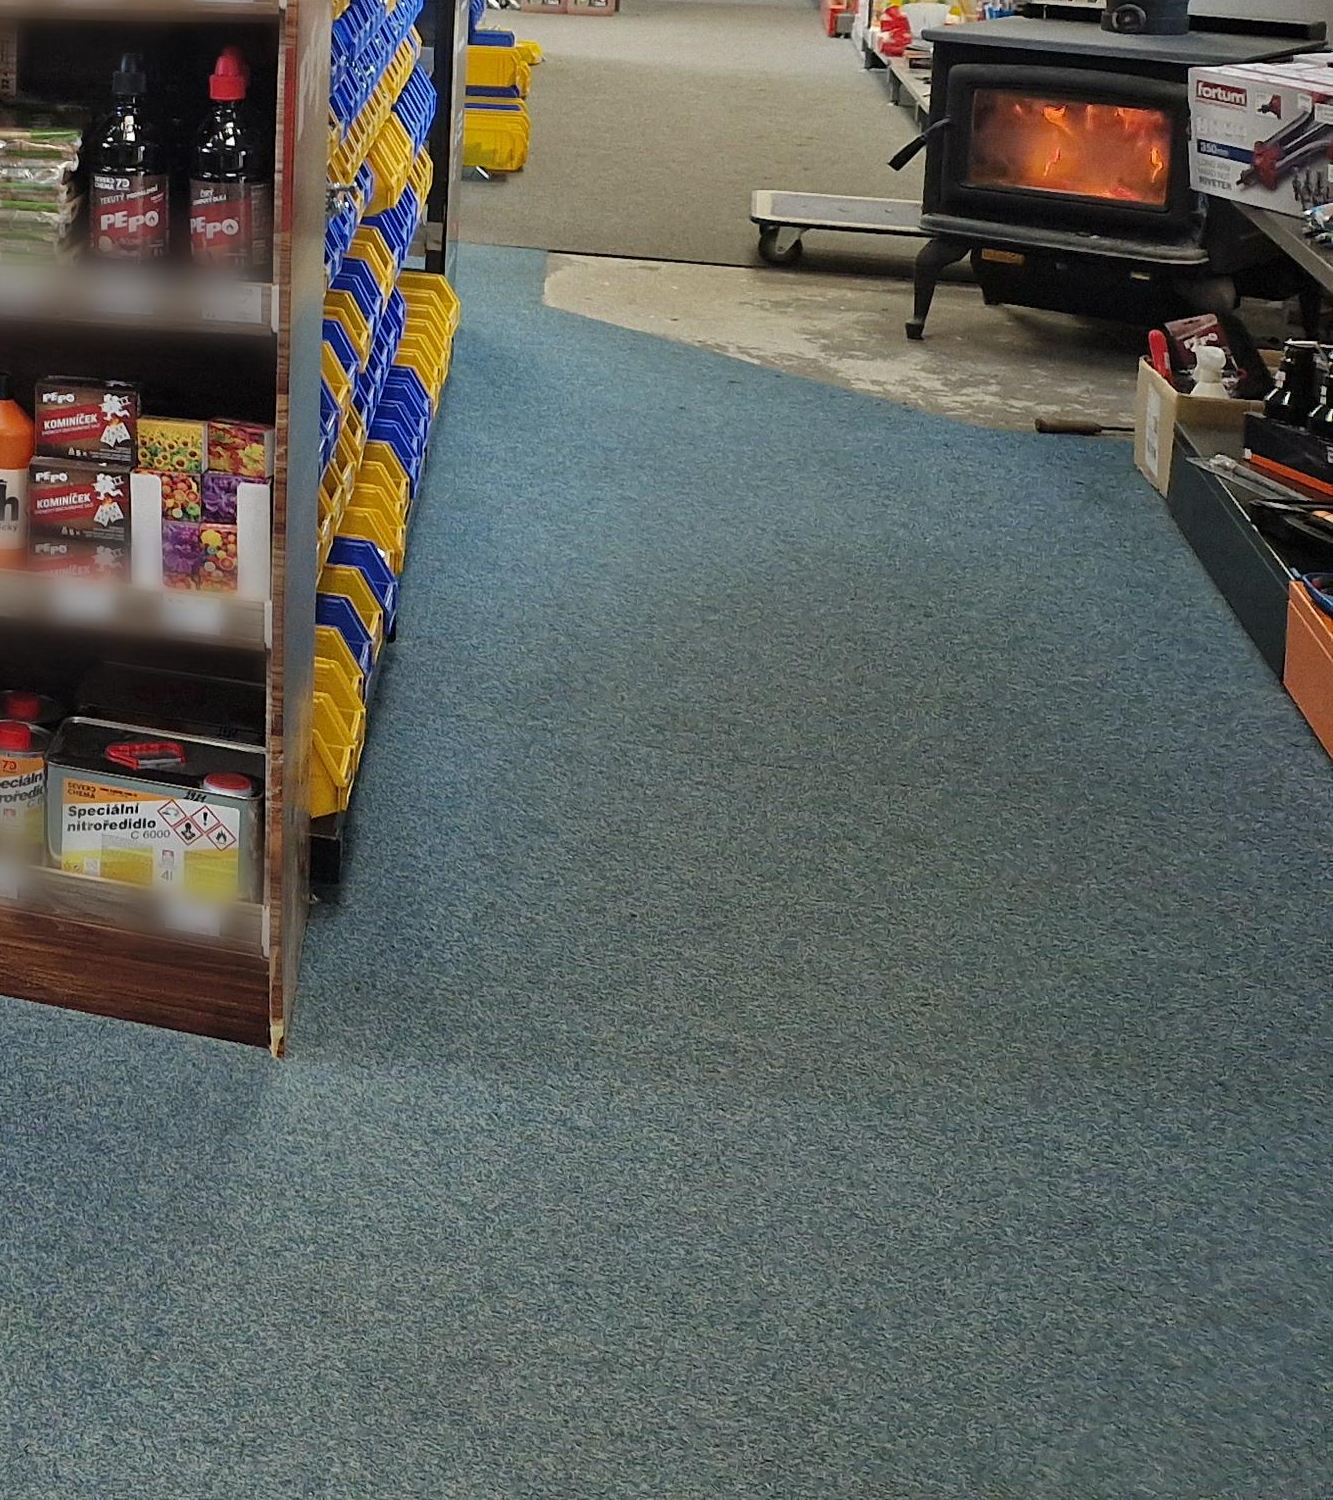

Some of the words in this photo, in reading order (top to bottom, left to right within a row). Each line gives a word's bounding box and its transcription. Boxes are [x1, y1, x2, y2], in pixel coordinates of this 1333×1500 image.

[1198, 81, 1247, 106] fortum
[1199, 176, 1232, 190] RIVETER
[100, 210, 159, 233] PEPO
[190, 216, 239, 239] PEPO
[42, 391, 75, 404] PEPO
[44, 413, 98, 431] KOMINÍČEK
[36, 471, 68, 483] PEPO
[36, 492, 91, 509] KOMINÍČEK
[35, 543, 68, 555] PEPO
[68, 788, 96, 799] CHEMA
[68, 803, 140, 818] Speciální
[67, 818, 156, 832] nitroředidlo
[130, 831, 139, 840] C
[143, 830, 171, 839] 6000
